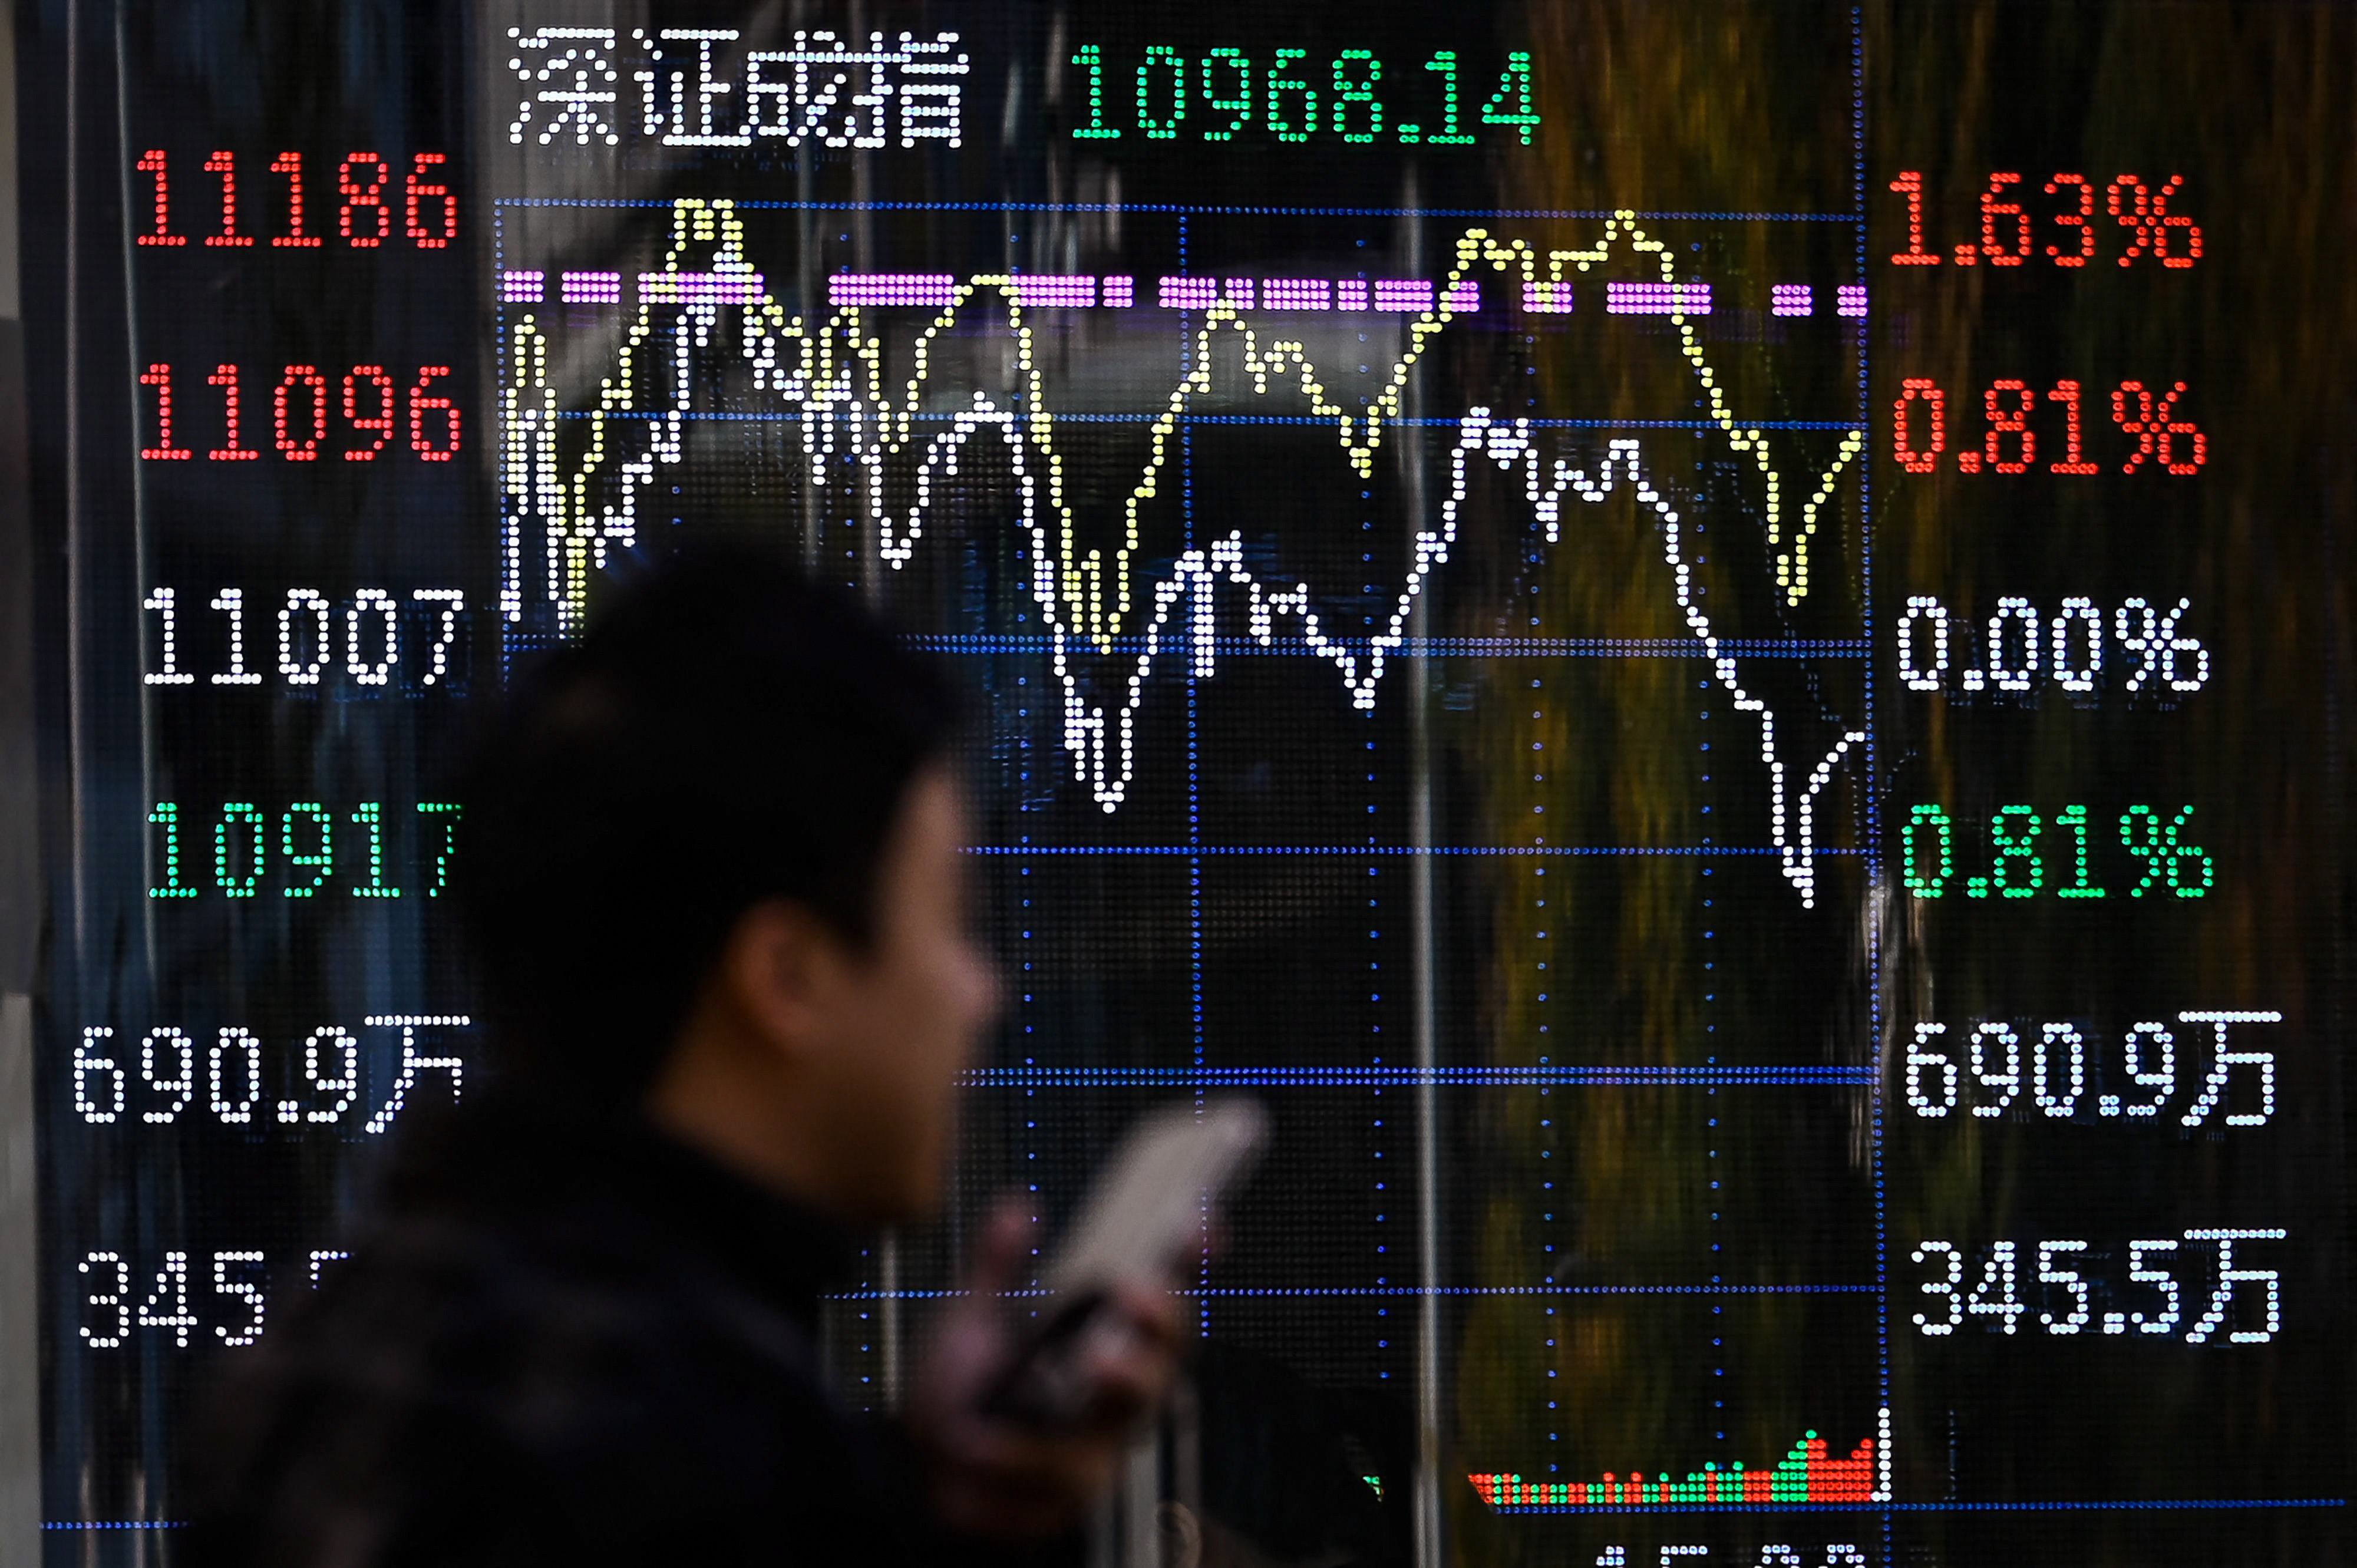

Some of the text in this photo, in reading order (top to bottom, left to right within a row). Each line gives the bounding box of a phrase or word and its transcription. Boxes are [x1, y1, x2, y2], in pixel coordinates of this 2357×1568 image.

[507, 27, 1541, 148] 深证成指 10968.14
[137, 150, 456, 249] 11186
[1889, 171, 2202, 268] 1.63%
[140, 364, 461, 461] 11096
[1894, 378, 2206, 475] 0.81%
[143, 587, 464, 685] 11007
[1897, 596, 2209, 691] 0.00%
[147, 802, 461, 898] 10917
[1901, 804, 2213, 898] 0.81%
[1906, 1011, 2282, 1127] 690.9万
[1911, 1229, 2286, 1343] 345.5万
